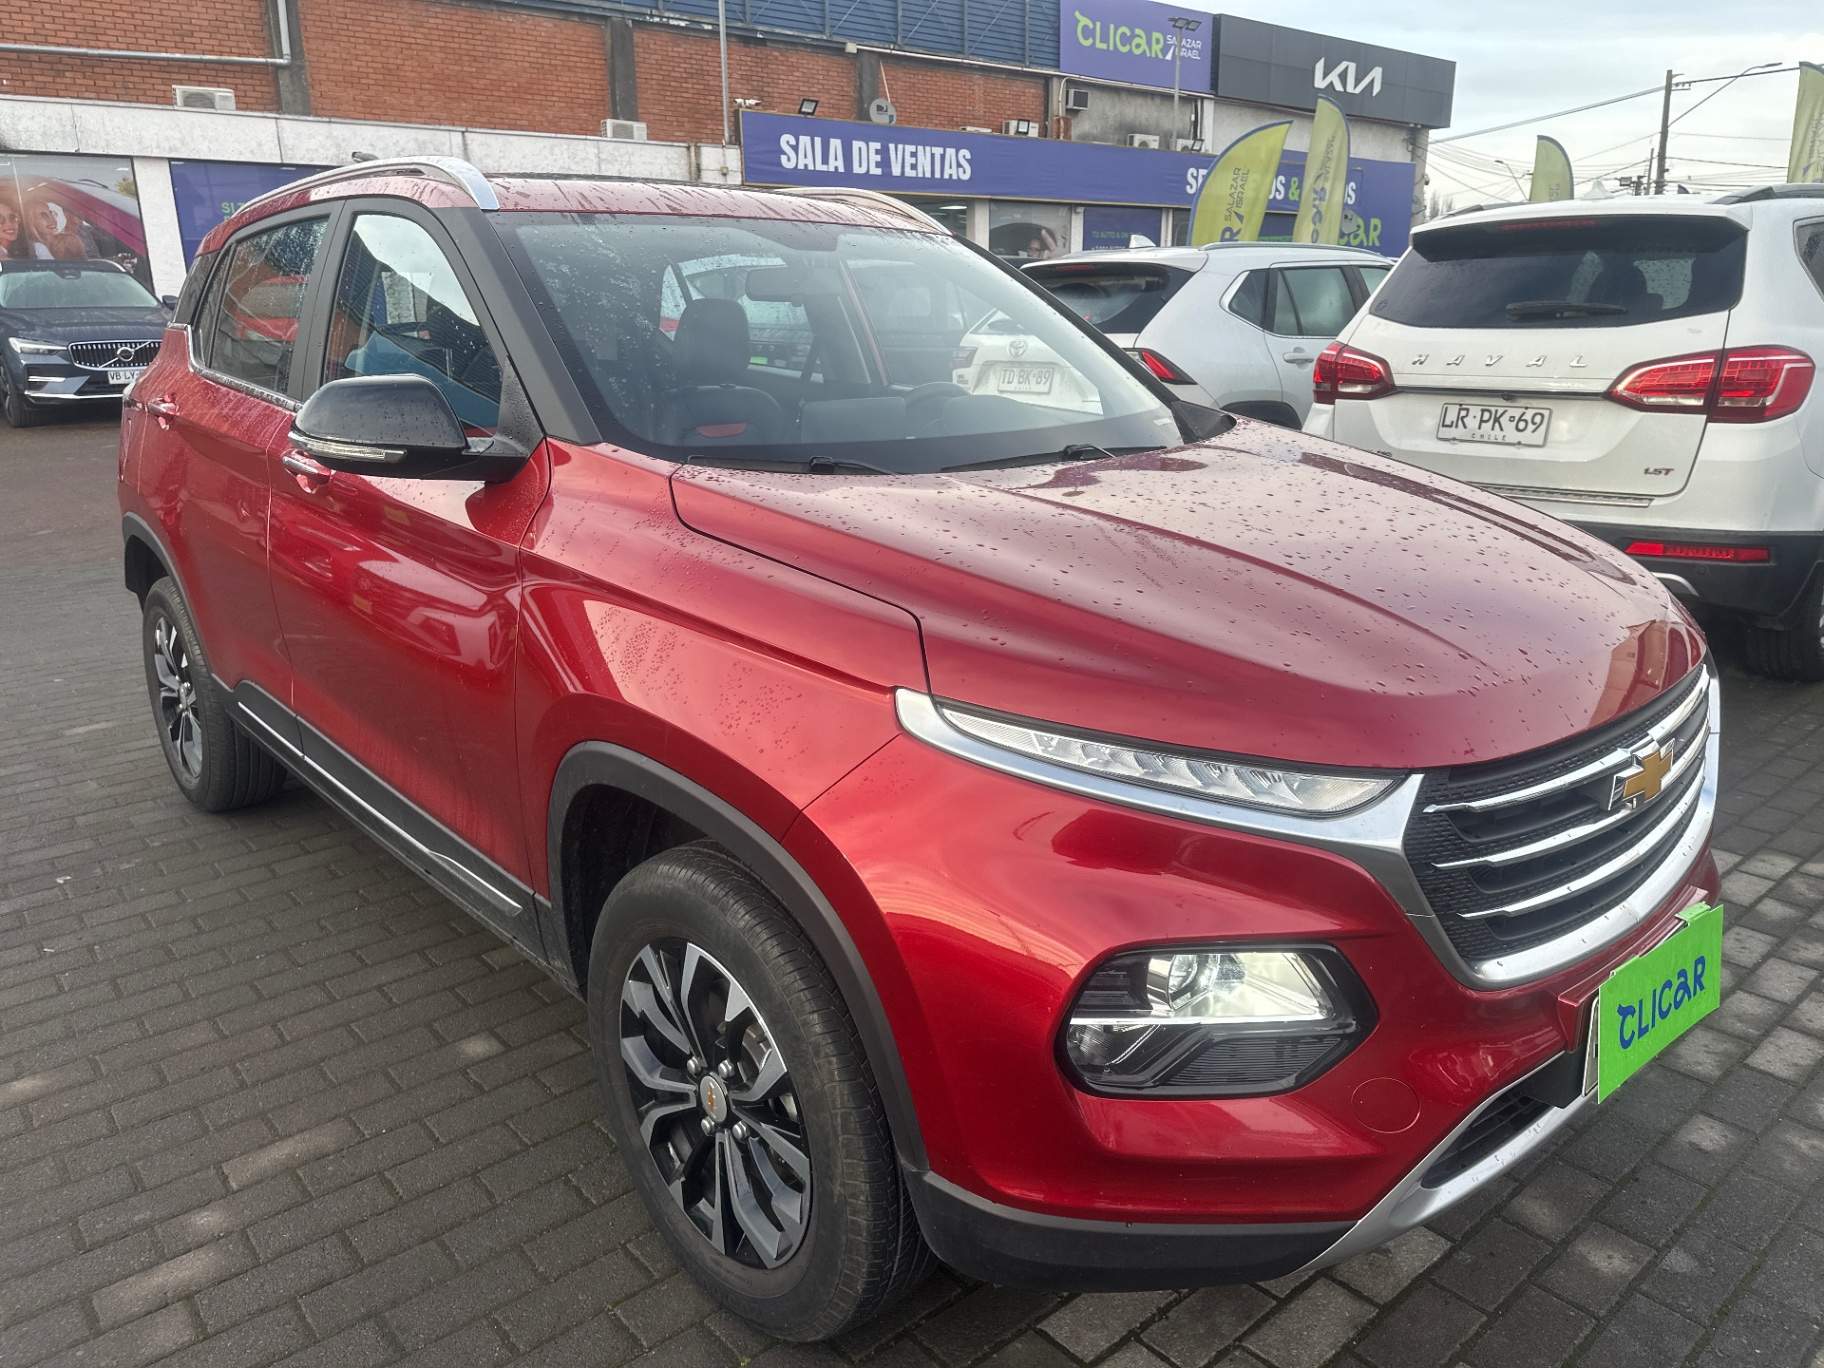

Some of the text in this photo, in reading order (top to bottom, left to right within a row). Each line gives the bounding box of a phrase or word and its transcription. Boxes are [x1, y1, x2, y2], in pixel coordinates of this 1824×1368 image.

[1166, 34, 1202, 49] SAAZAR
[1313, 56, 1383, 97] KIA
[779, 133, 972, 181] SALA DE VENTAS
[1223, 167, 1241, 222] SALAZAR
[1411, 354, 1589, 368] HAVAL
[1471, 433, 1506, 441] CHILE
